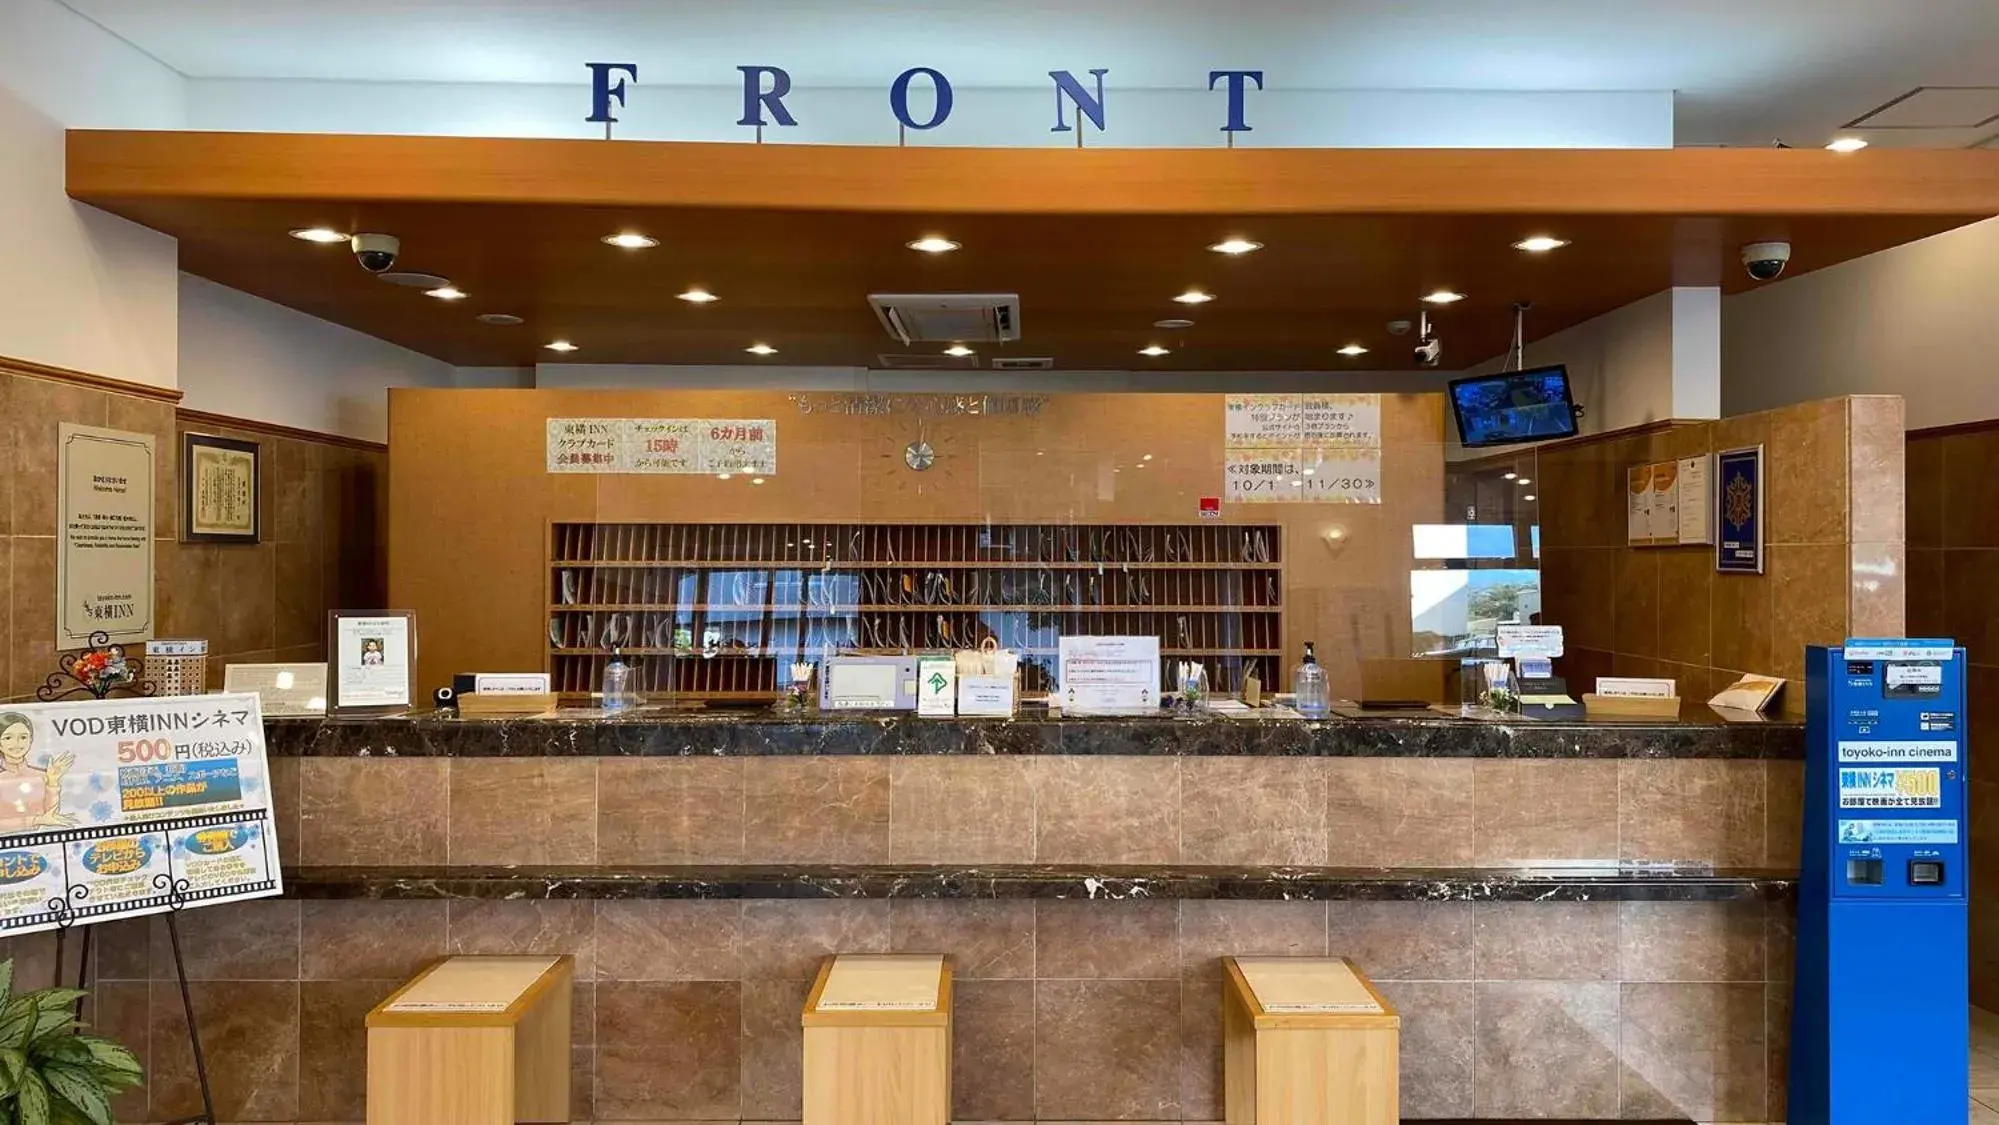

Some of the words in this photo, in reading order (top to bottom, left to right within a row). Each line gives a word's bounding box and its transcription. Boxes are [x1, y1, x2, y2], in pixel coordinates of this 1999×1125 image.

[585, 62, 1264, 132] FRONT
[557, 437, 616, 450] クラブカード
[646, 436, 680, 453] 15時
[94, 603, 135, 620] 東横INN
[52, 709, 251, 738] VOD東横INNシネマ
[1842, 746, 1905, 760] toyoko-inn
[1908, 746, 1952, 757] cinema
[89, 847, 146, 865] テレビから
